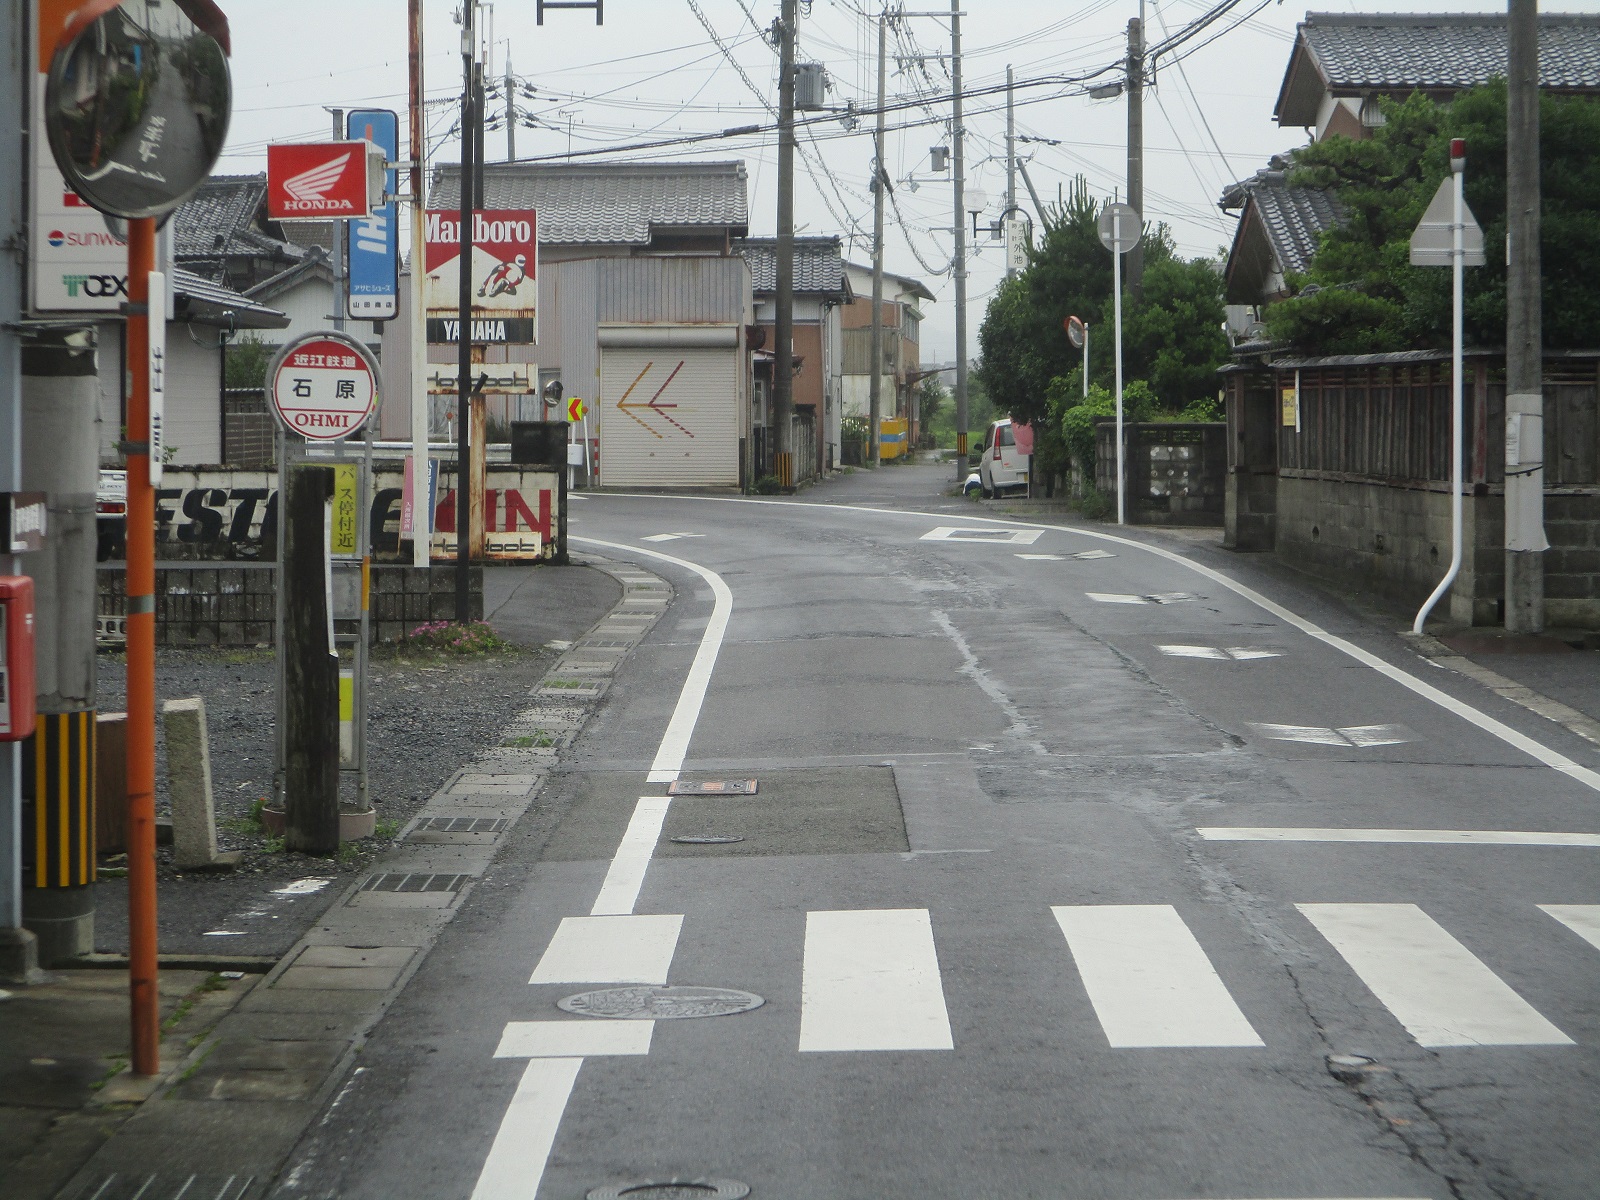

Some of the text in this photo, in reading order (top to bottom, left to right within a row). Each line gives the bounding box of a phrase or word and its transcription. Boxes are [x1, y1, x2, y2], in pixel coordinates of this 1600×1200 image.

[283, 199, 354, 211] HONDA
[425, 213, 531, 243] Maboro
[443, 320, 506, 341] YAAHA
[293, 353, 356, 368] 近江鉄道
[292, 378, 356, 399] 石原
[294, 413, 349, 428] OHMI
[337, 466, 355, 548] バス停付近
